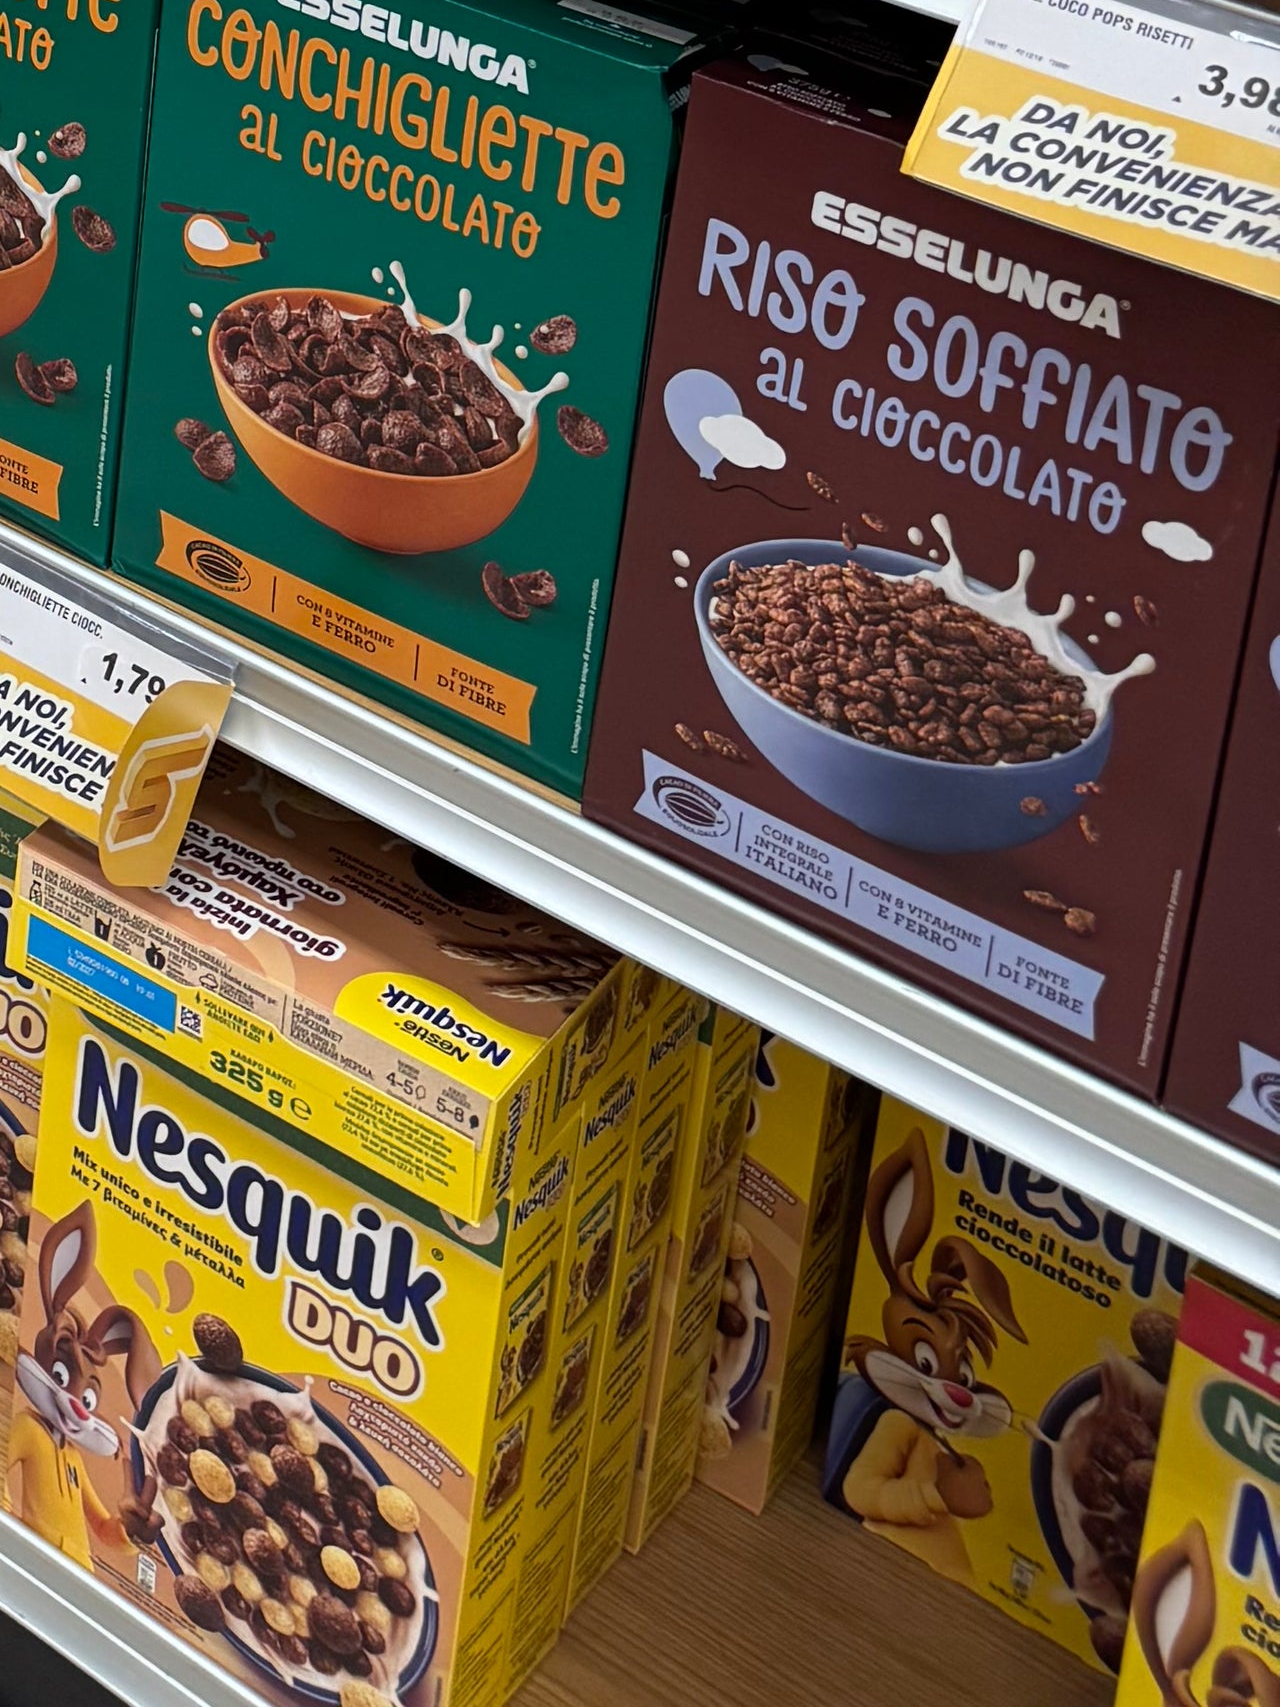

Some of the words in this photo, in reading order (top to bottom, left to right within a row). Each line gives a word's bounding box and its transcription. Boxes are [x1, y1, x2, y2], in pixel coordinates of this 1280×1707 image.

[1092, 7, 1134, 31] POPS
[1136, 22, 1194, 50] RISETTI
[1021, 103, 1080, 135] DA
[1085, 120, 1169, 159] NOI,
[811, 190, 1124, 340] ESSELUNGA
[450, 666, 497, 694] FONTE
[14, 690, 67, 729] NOI,
[754, 835, 835, 882] INTEGRALE
[760, 822, 792, 848] CON
[795, 837, 832, 866] RISO
[745, 845, 840, 902] ITALIANO
[998, 962, 1028, 986] DI
[1031, 974, 1086, 1015] FIBRE
[1016, 952, 1071, 988] FONTE
[382, 984, 511, 1068] Nesquik
[73, 1146, 99, 1174] Mix
[102, 1165, 140, 1200] unico
[143, 1195, 153, 1208] e
[154, 1199, 244, 1267] irresistibile
[77, 1040, 442, 1346] Nesquik
[954, 1213, 1113, 1309] cioccolatoso
[957, 1189, 1032, 1246] Rende
[1037, 1226, 1057, 1259] il
[1060, 1238, 1122, 1291] latte
[288, 1281, 421, 1397] DUO
